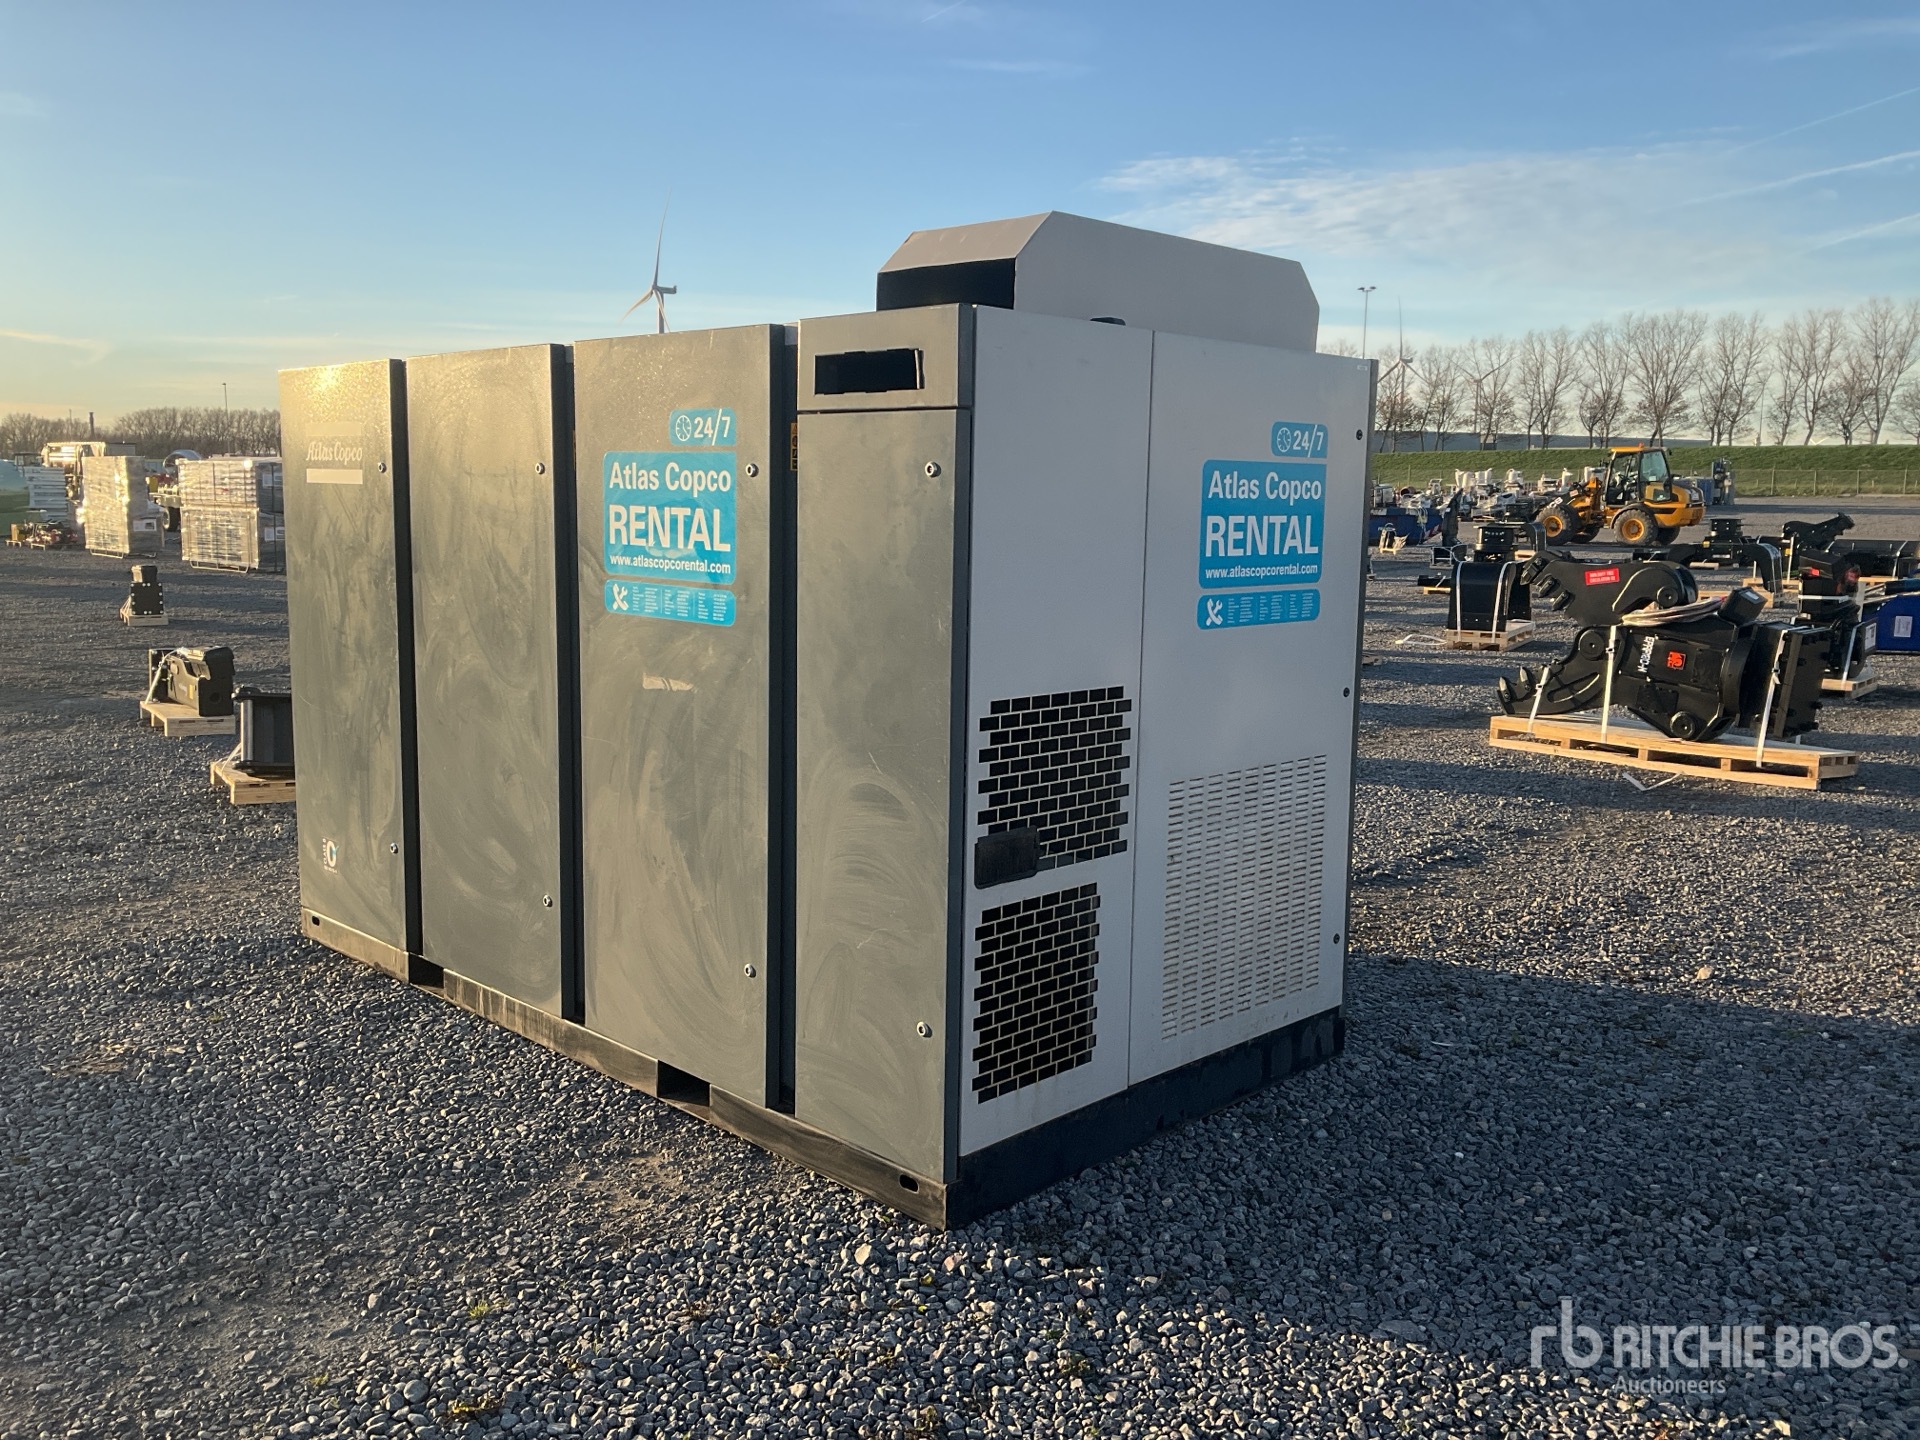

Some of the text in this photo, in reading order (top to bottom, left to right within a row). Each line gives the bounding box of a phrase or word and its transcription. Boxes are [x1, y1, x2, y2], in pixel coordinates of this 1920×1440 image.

[693, 408, 731, 446] 24/7
[1292, 424, 1324, 458] 24/7
[334, 441, 363, 466] Copco
[609, 461, 731, 498] Atlas Copco
[1208, 470, 1322, 506] Atlas Copco
[609, 504, 731, 552] RENTAL
[1205, 515, 1319, 557] RENTAL
[609, 554, 731, 574] www.atlascopcorental.com
[1205, 563, 1318, 579] www.atlascopcorental.com
